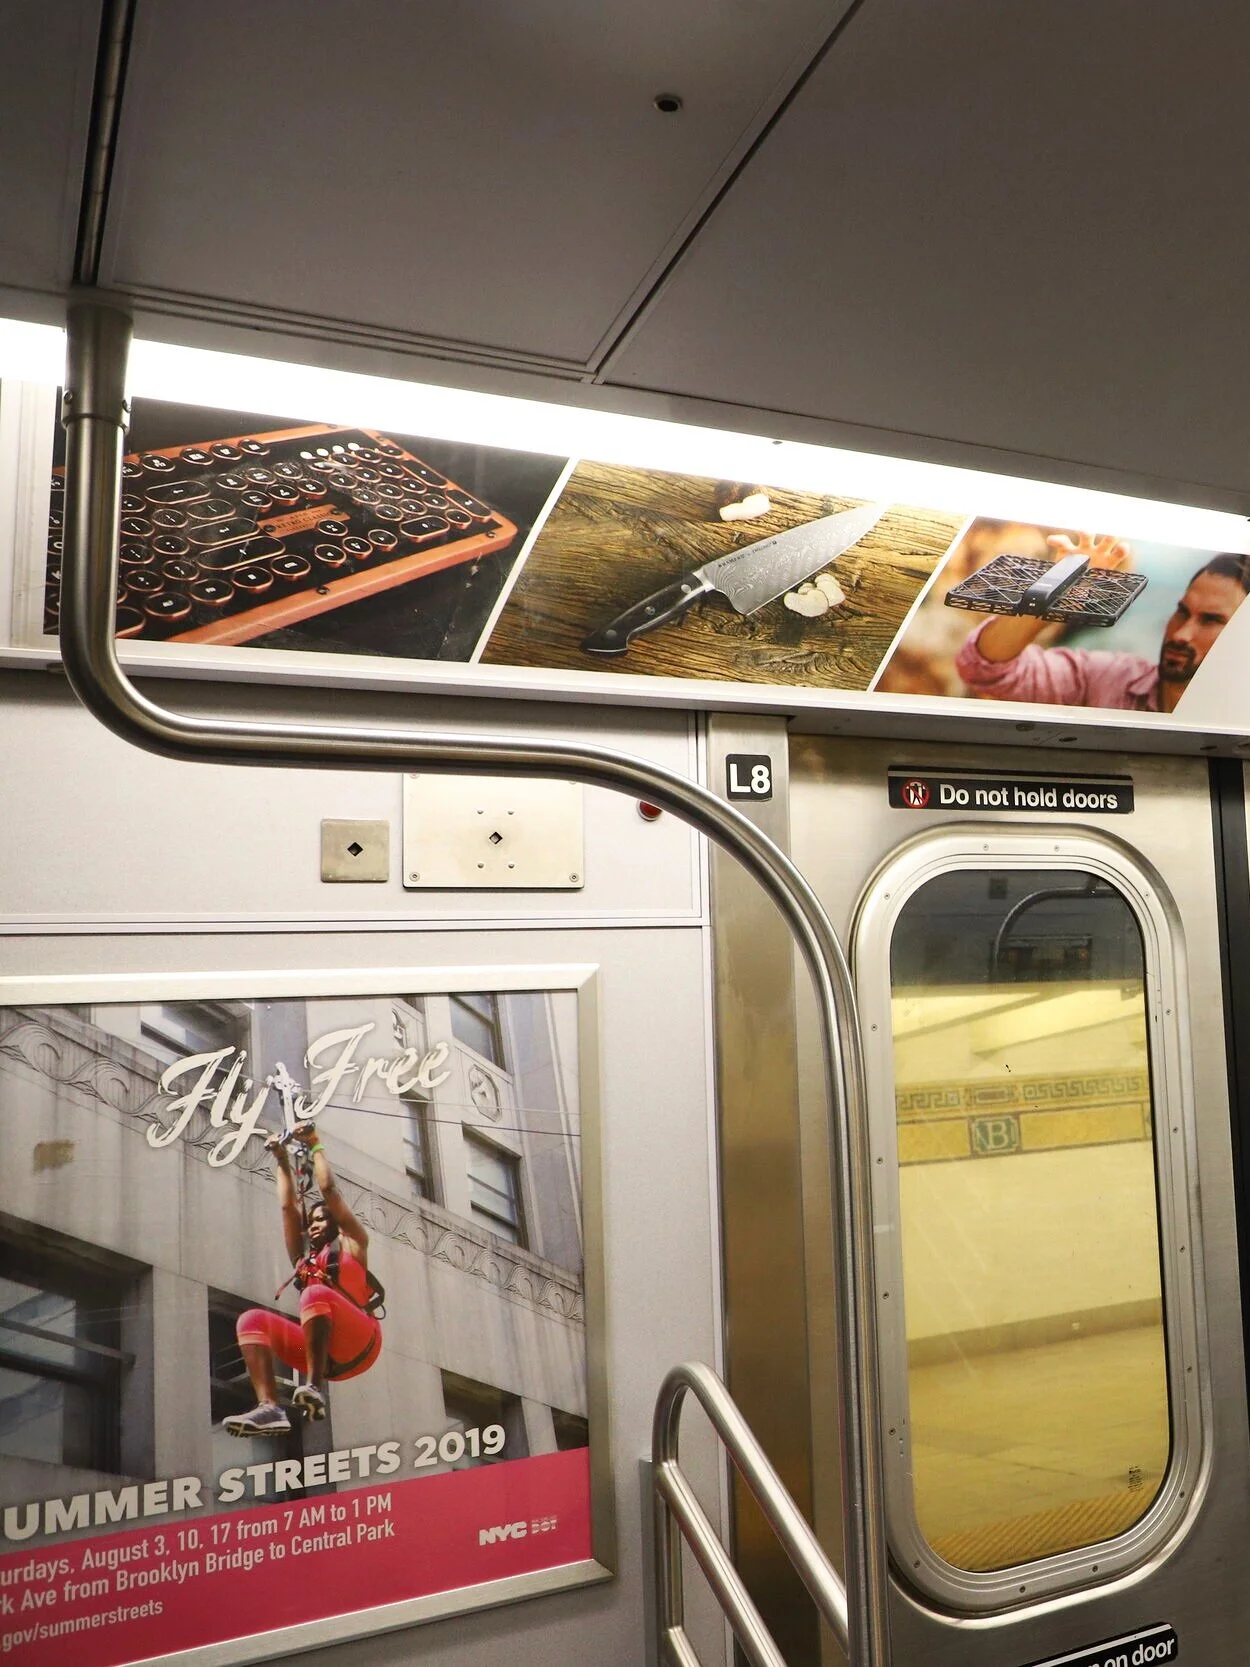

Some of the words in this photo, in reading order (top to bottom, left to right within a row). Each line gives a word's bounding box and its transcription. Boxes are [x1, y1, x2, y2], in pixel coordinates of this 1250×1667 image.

[729, 763, 771, 794] L8
[939, 783, 969, 805] Do
[974, 787, 1009, 807] not
[1014, 786, 1057, 808] hold
[1062, 788, 1118, 810] doors
[146, 1045, 274, 1168] Fly
[295, 1022, 450, 1119] Free
[985, 1120, 1009, 1149] B
[4, 1476, 204, 1541] UMMER
[218, 1441, 401, 1503] STREETS
[414, 1424, 506, 1469] 2019
[82, 1538, 149, 1571] August
[154, 1534, 171, 1557] 3,
[177, 1528, 204, 1551] 10,
[211, 1522, 231, 1545] 17
[237, 1519, 278, 1541] from
[284, 1511, 295, 1532] 7
[299, 1504, 326, 1529] AM
[330, 1504, 347, 1523] to
[352, 1498, 359, 1518] 1
[366, 1492, 393, 1516] PM
[479, 1521, 528, 1546] NYC
[20, 1588, 58, 1612] Ave
[64, 1577, 110, 1602] from
[116, 1559, 200, 1592] Brooklyn
[205, 1547, 264, 1574] Bridge
[269, 1541, 285, 1561] to
[291, 1527, 352, 1555] Central
[356, 1518, 395, 1544] Park
[1131, 1638, 1175, 1666] door
